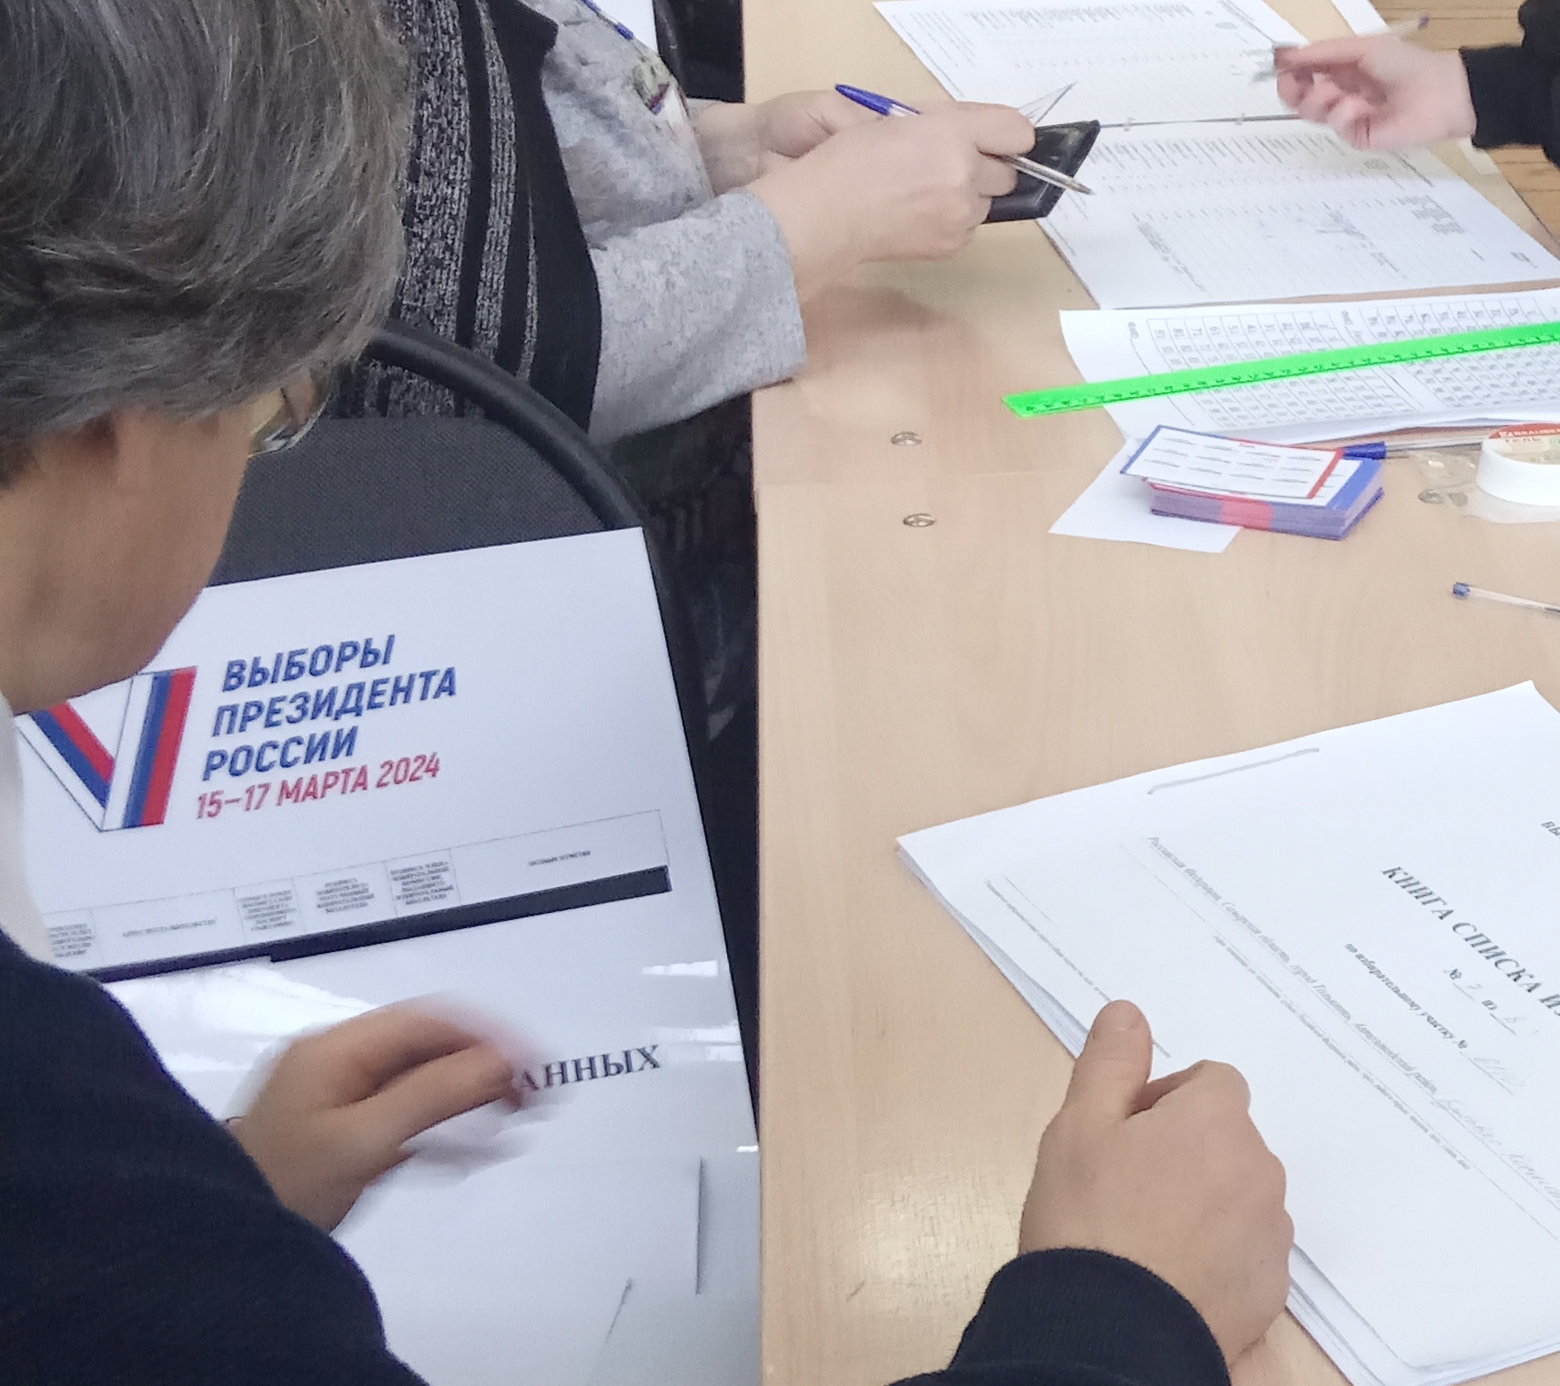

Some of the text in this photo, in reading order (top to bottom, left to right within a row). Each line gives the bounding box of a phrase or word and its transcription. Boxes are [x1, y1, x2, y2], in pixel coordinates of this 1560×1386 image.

[221, 635, 396, 691] ВЫБОРЫ
[212, 667, 457, 737] ПРЕЗИДЕНТА
[202, 727, 359, 781] РОССИИ
[278, 768, 369, 808] МАРТА
[377, 752, 441, 790] 2024
[1381, 866, 1455, 920] КНИГА
[1452, 921, 1541, 993] СПИСКА
[519, 1044, 661, 1092] АННЫХ
